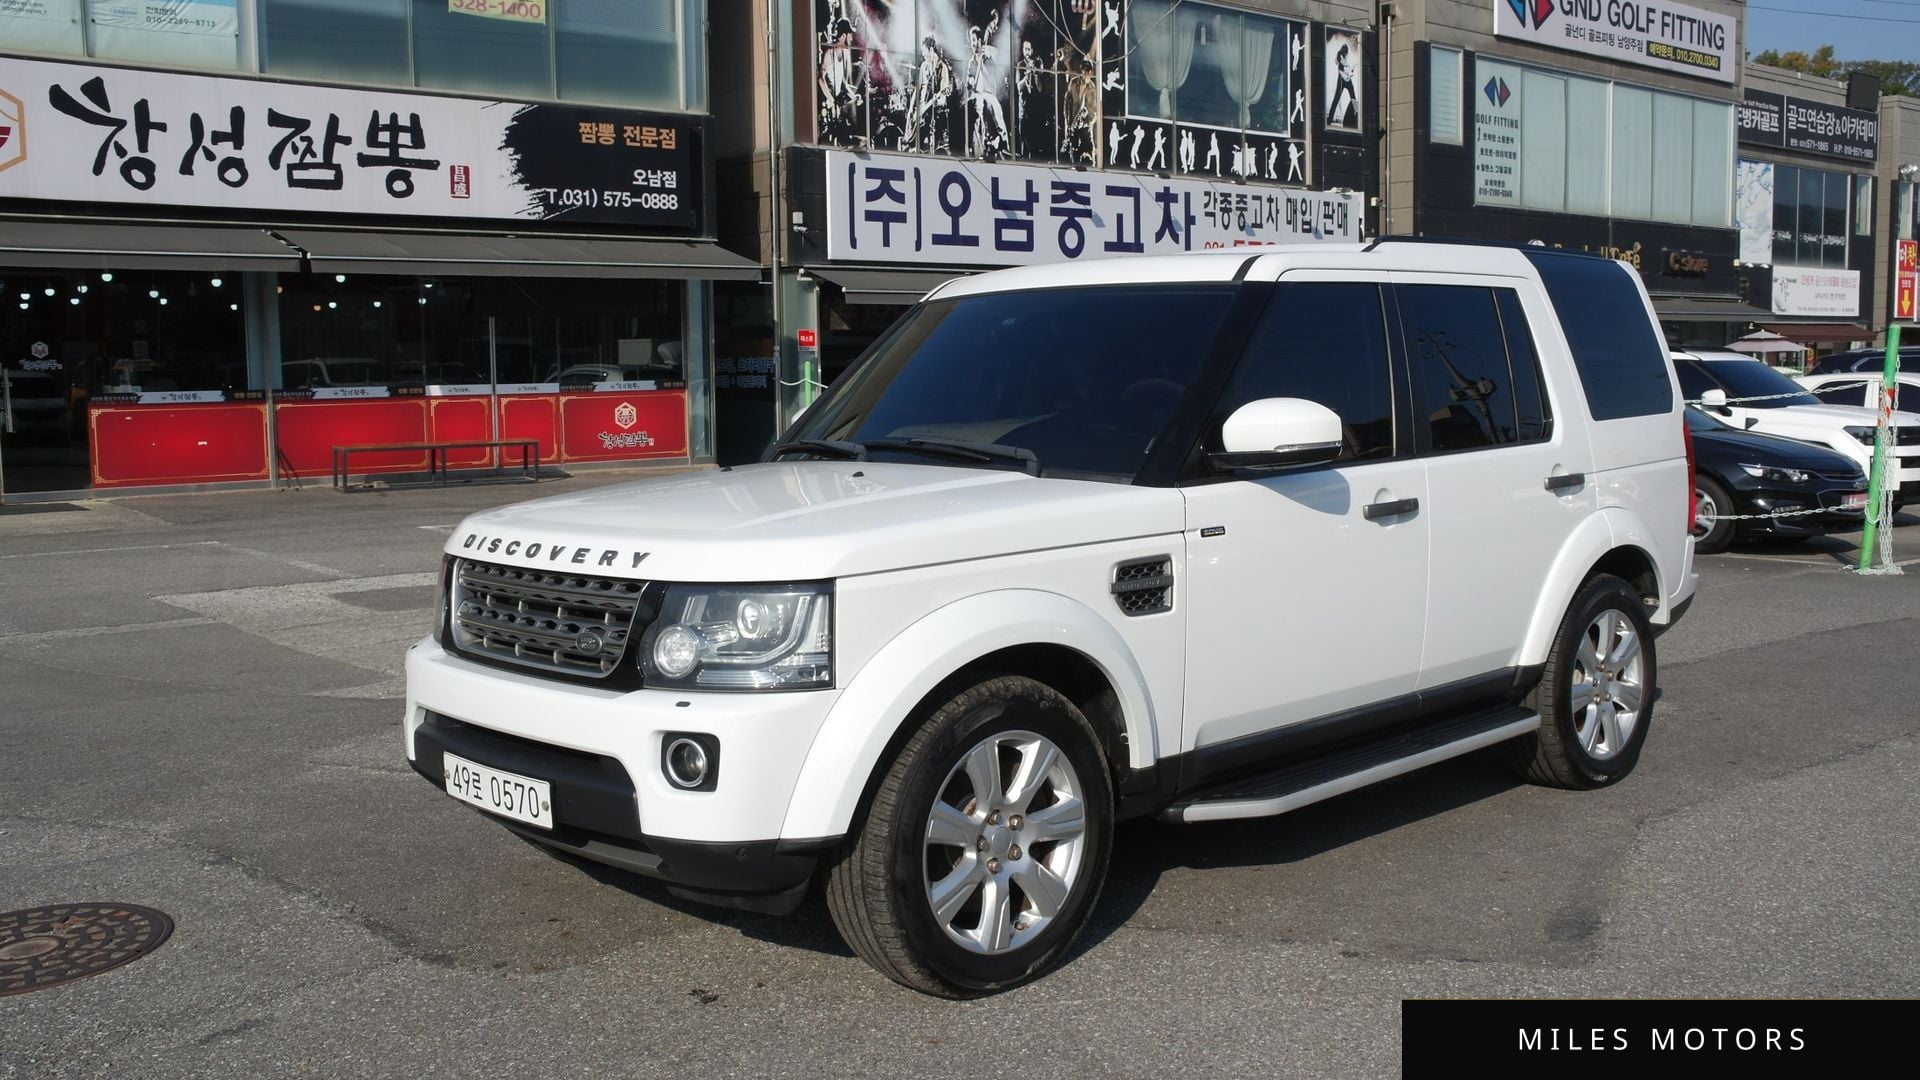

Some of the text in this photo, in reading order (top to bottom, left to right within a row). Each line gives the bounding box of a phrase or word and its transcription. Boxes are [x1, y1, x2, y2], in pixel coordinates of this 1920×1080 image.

[1560, 0, 1725, 50] GND GOLF FITTING
[1617, 35, 1644, 52] 남양주점
[49, 76, 441, 198] 창성짬뽕
[578, 122, 676, 149] 짬뽕 전문점
[1475, 113, 1519, 129] GOLF FITTING
[1738, 107, 1779, 132] 벙커골프
[1787, 105, 1877, 143] 골프연습장&아카데미
[632, 168, 677, 188] 오남점
[603, 191, 678, 210] 575-0888
[849, 162, 1196, 258] (주)오남중고차
[1203, 190, 1348, 237] 각종중고차 매입/판매
[463, 533, 651, 568] DISCOVERY
[453, 763, 539, 818] 49로 0570
